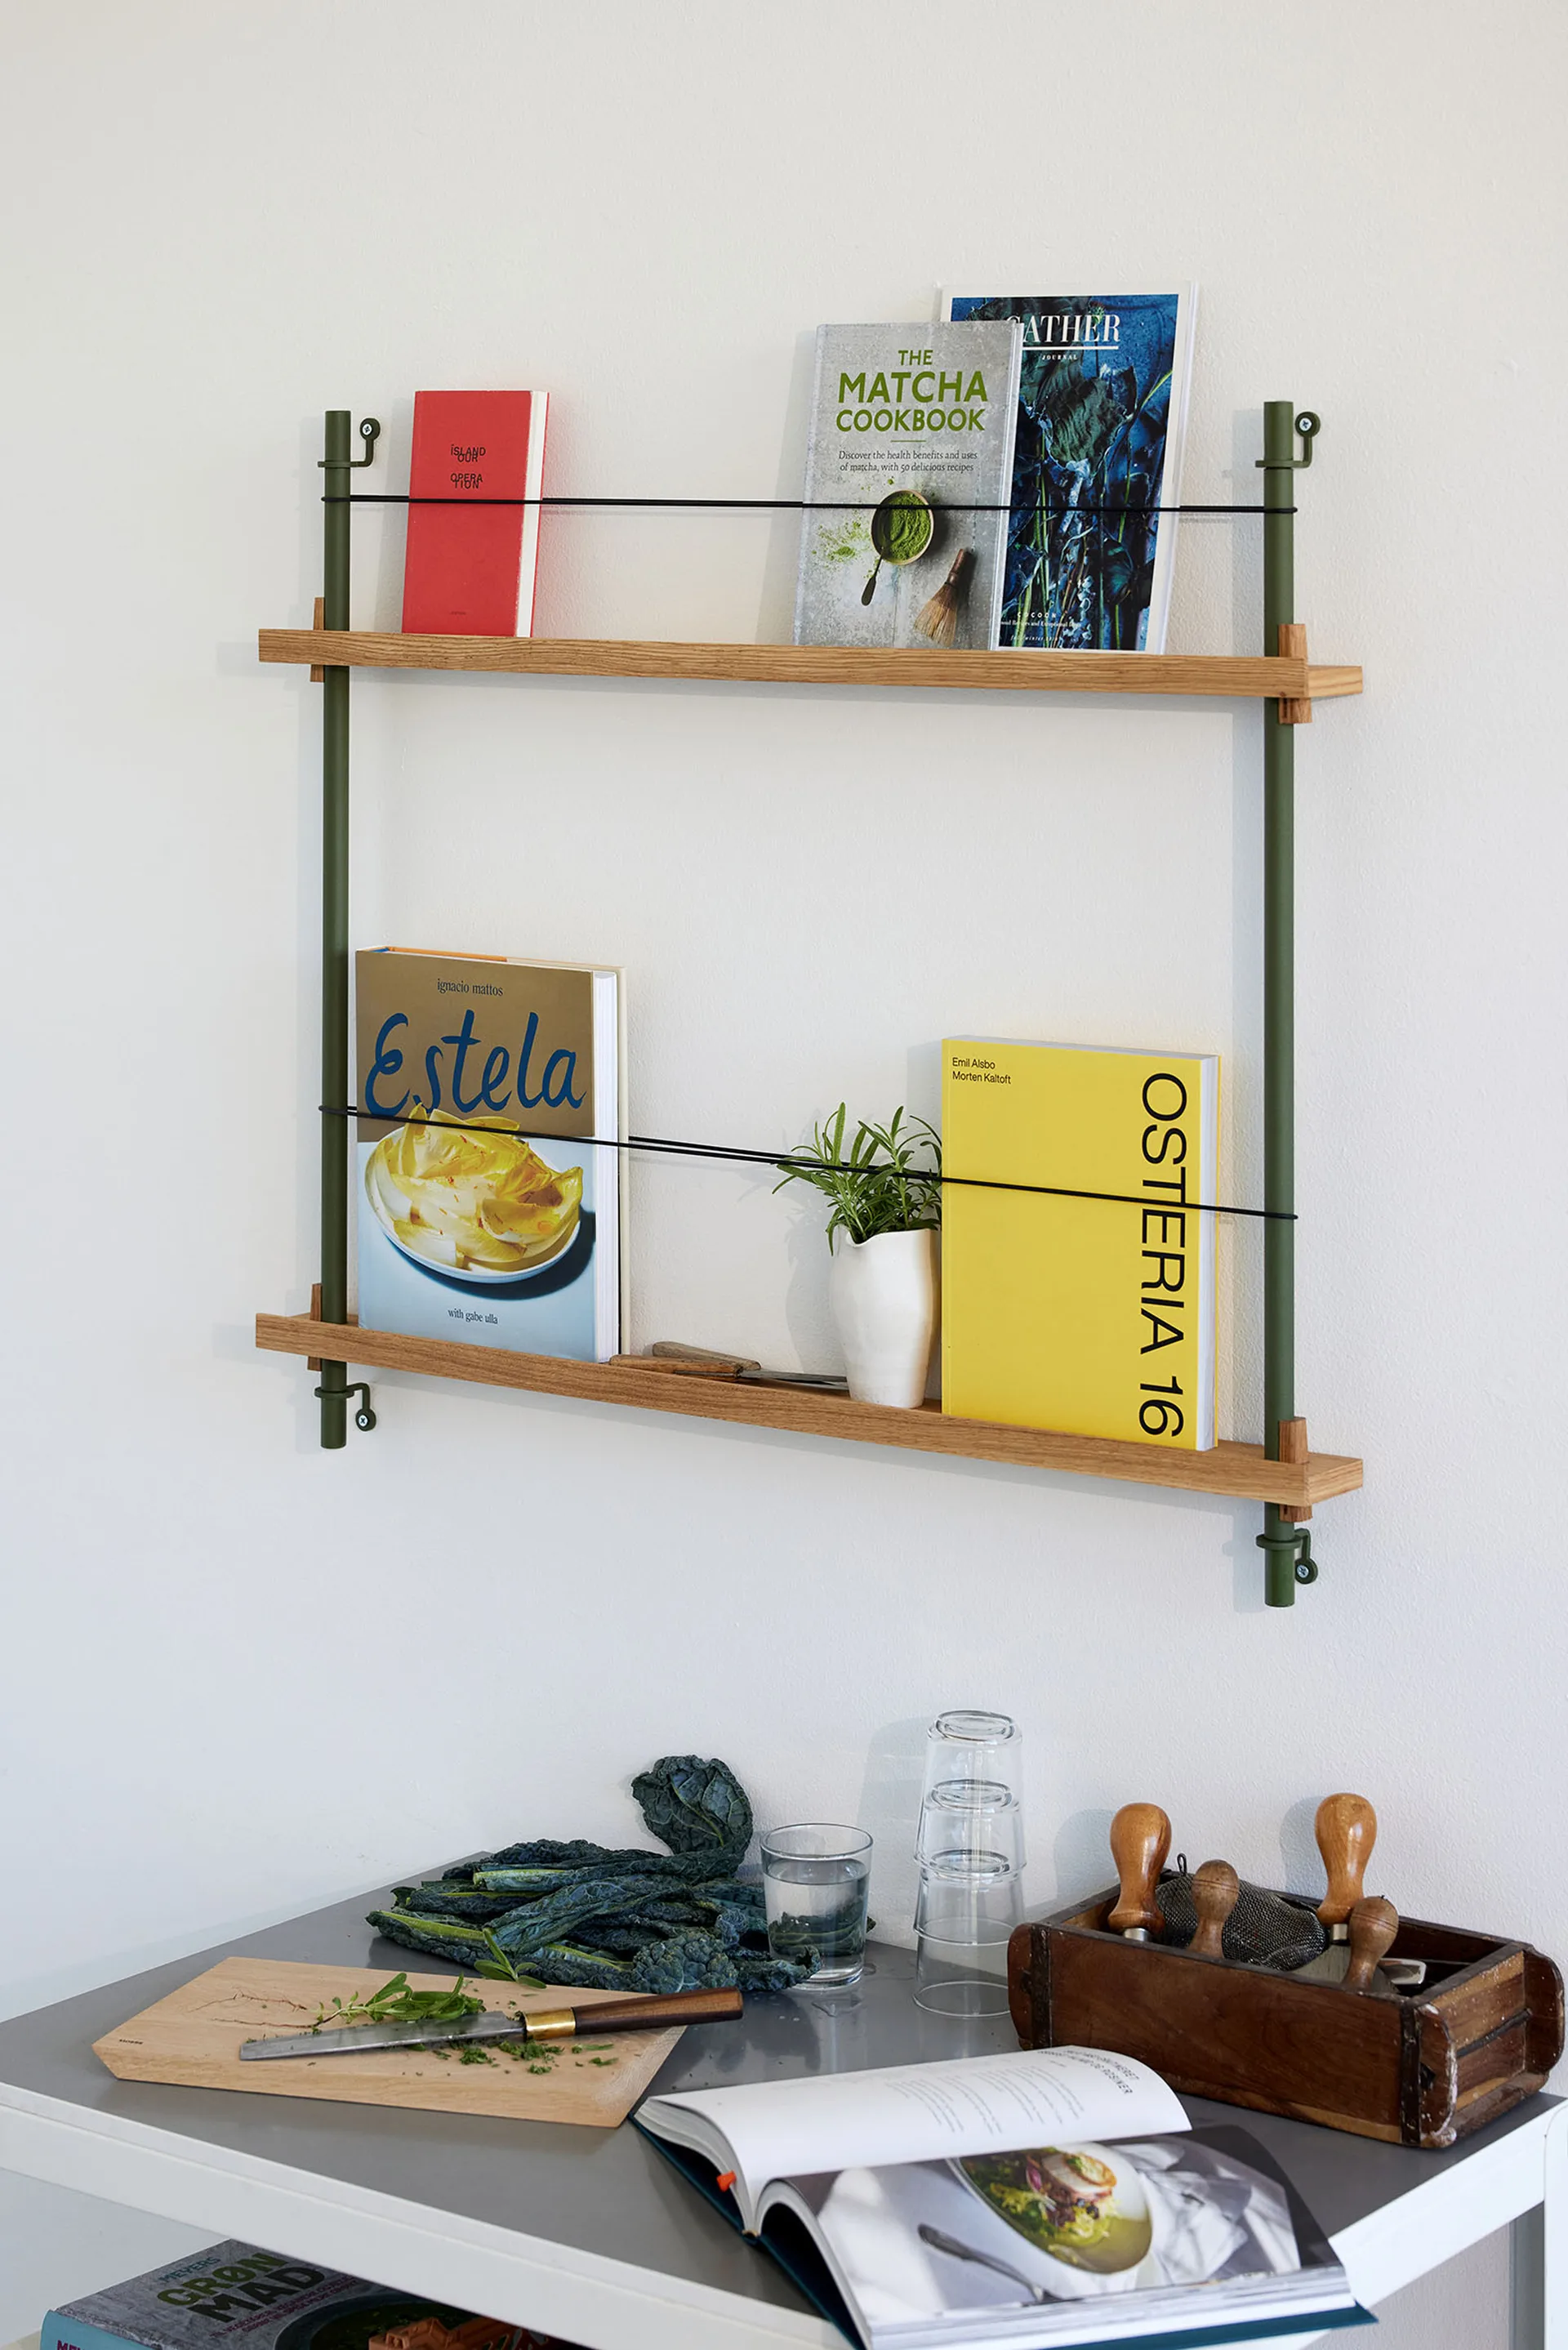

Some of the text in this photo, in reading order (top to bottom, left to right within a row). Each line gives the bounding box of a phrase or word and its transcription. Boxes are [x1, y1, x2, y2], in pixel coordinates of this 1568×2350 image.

[898, 350, 933, 366] THE
[838, 371, 988, 404] MATCHA
[836, 408, 985, 432] COOKBOOK
[839, 450, 978, 460] Discover the health benefits and uses
[840, 462, 974, 474] of matcha, with 50 delicious recipes
[450, 473, 483, 483] OPERA
[437, 978, 503, 997] ignacio mattos
[365, 1009, 587, 1116] Estela
[952, 1057, 996, 1069] Emil Alsbo
[952, 1071, 1011, 1084] Morten Kaltoft
[1138, 1072, 1187, 1438] OSTERIA 16
[448, 1309, 498, 1324] with gabe ulla
[157, 2252, 289, 2306] GRØN
[158, 2256, 220, 2284] MEYERS
[186, 2266, 326, 2323] MAD
